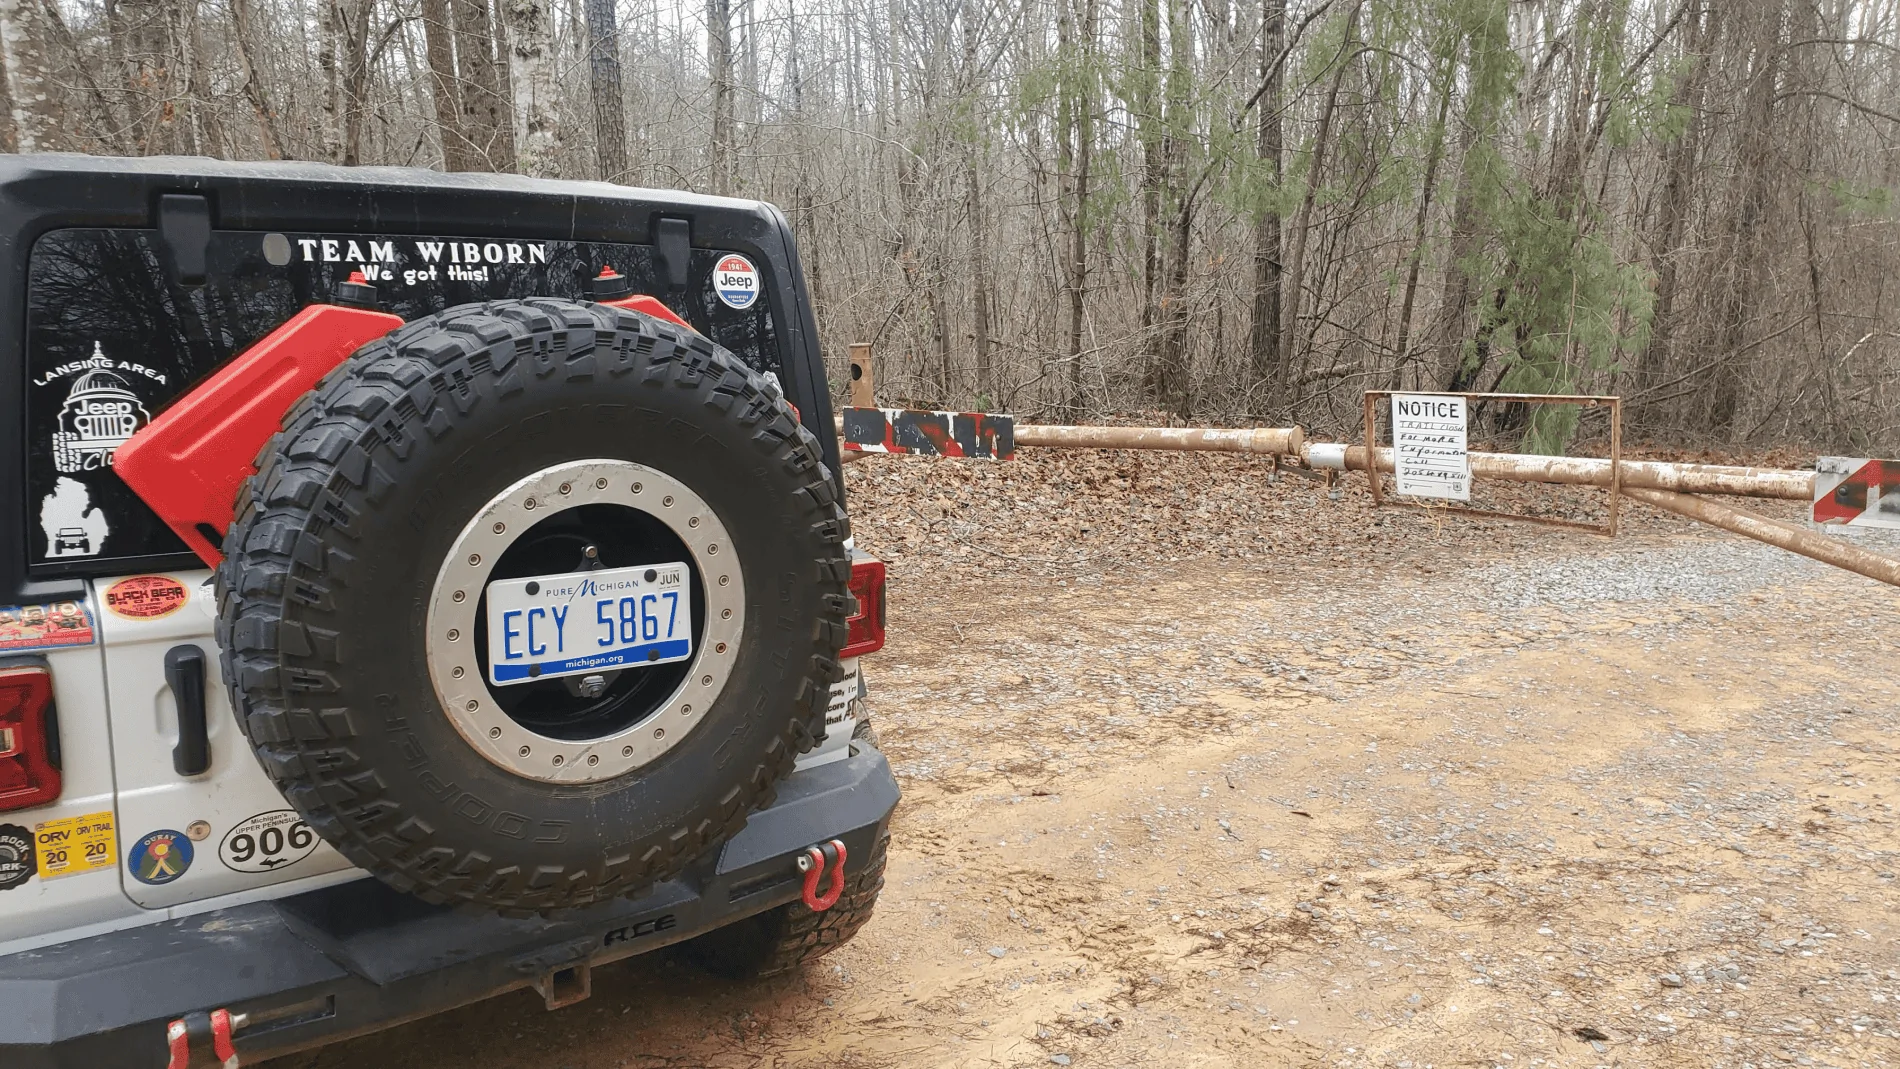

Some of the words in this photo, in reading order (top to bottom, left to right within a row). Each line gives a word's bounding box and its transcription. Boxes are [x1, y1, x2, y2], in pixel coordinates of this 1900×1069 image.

[298, 239, 396, 263] TEAM
[415, 241, 546, 264] WIBORN
[360, 264, 394, 282] We
[403, 265, 437, 286] got
[447, 265, 489, 282] this!
[728, 263, 743, 271] 1941
[720, 273, 753, 289] Jeep
[33, 359, 114, 386] LANSING
[117, 361, 167, 385] AREA
[75, 399, 132, 418] Jeep
[1398, 400, 1460, 419] NOTICE
[83, 449, 114, 471] Clu
[660, 573, 680, 585] JUN
[106, 589, 149, 605] BLACK
[150, 586, 185, 599] BEAR
[546, 587, 573, 598] PURE
[570, 579, 639, 602] MICHIGAN
[503, 604, 569, 660] ECY
[597, 592, 679, 647] 5867
[565, 655, 624, 668] michigan.org
[250, 812, 288, 825] Michigan's
[38, 830, 71, 844] ORV
[76, 825, 92, 836] ORV
[92, 822, 113, 833] TRAIL
[235, 824, 261, 836] UPPER
[143, 834, 177, 847] OURAY
[229, 820, 313, 863] 906
[46, 850, 68, 865] 20
[85, 842, 107, 857] 20
[603, 914, 676, 947] ACE
